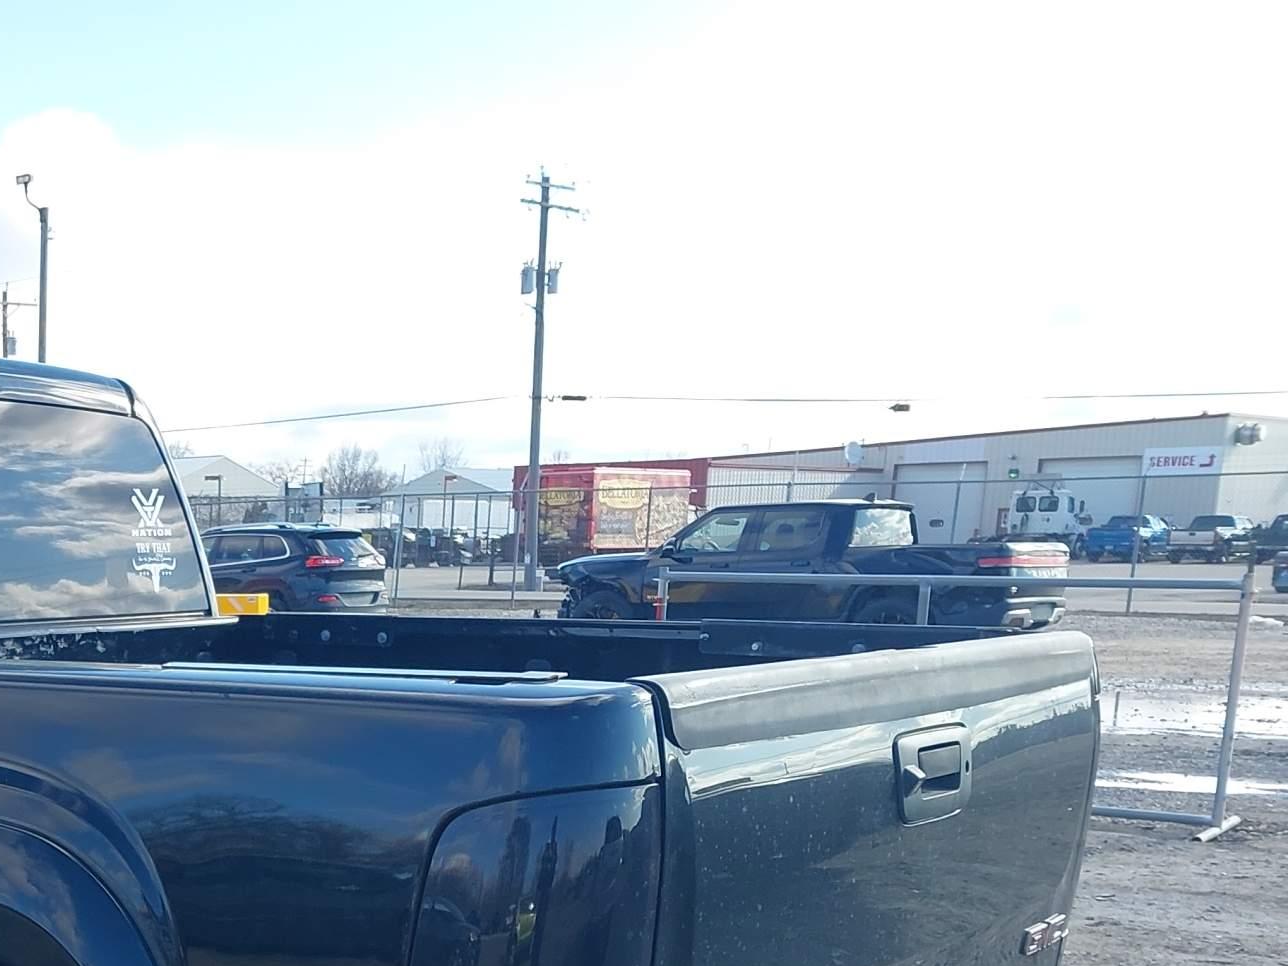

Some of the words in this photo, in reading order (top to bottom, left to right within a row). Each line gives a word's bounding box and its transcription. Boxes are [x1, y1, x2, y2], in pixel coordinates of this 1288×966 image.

[1149, 455, 1195, 467] SERVICE
[131, 528, 172, 537] NATION
[135, 542, 151, 554] TRY
[152, 542, 171, 553] THAT
